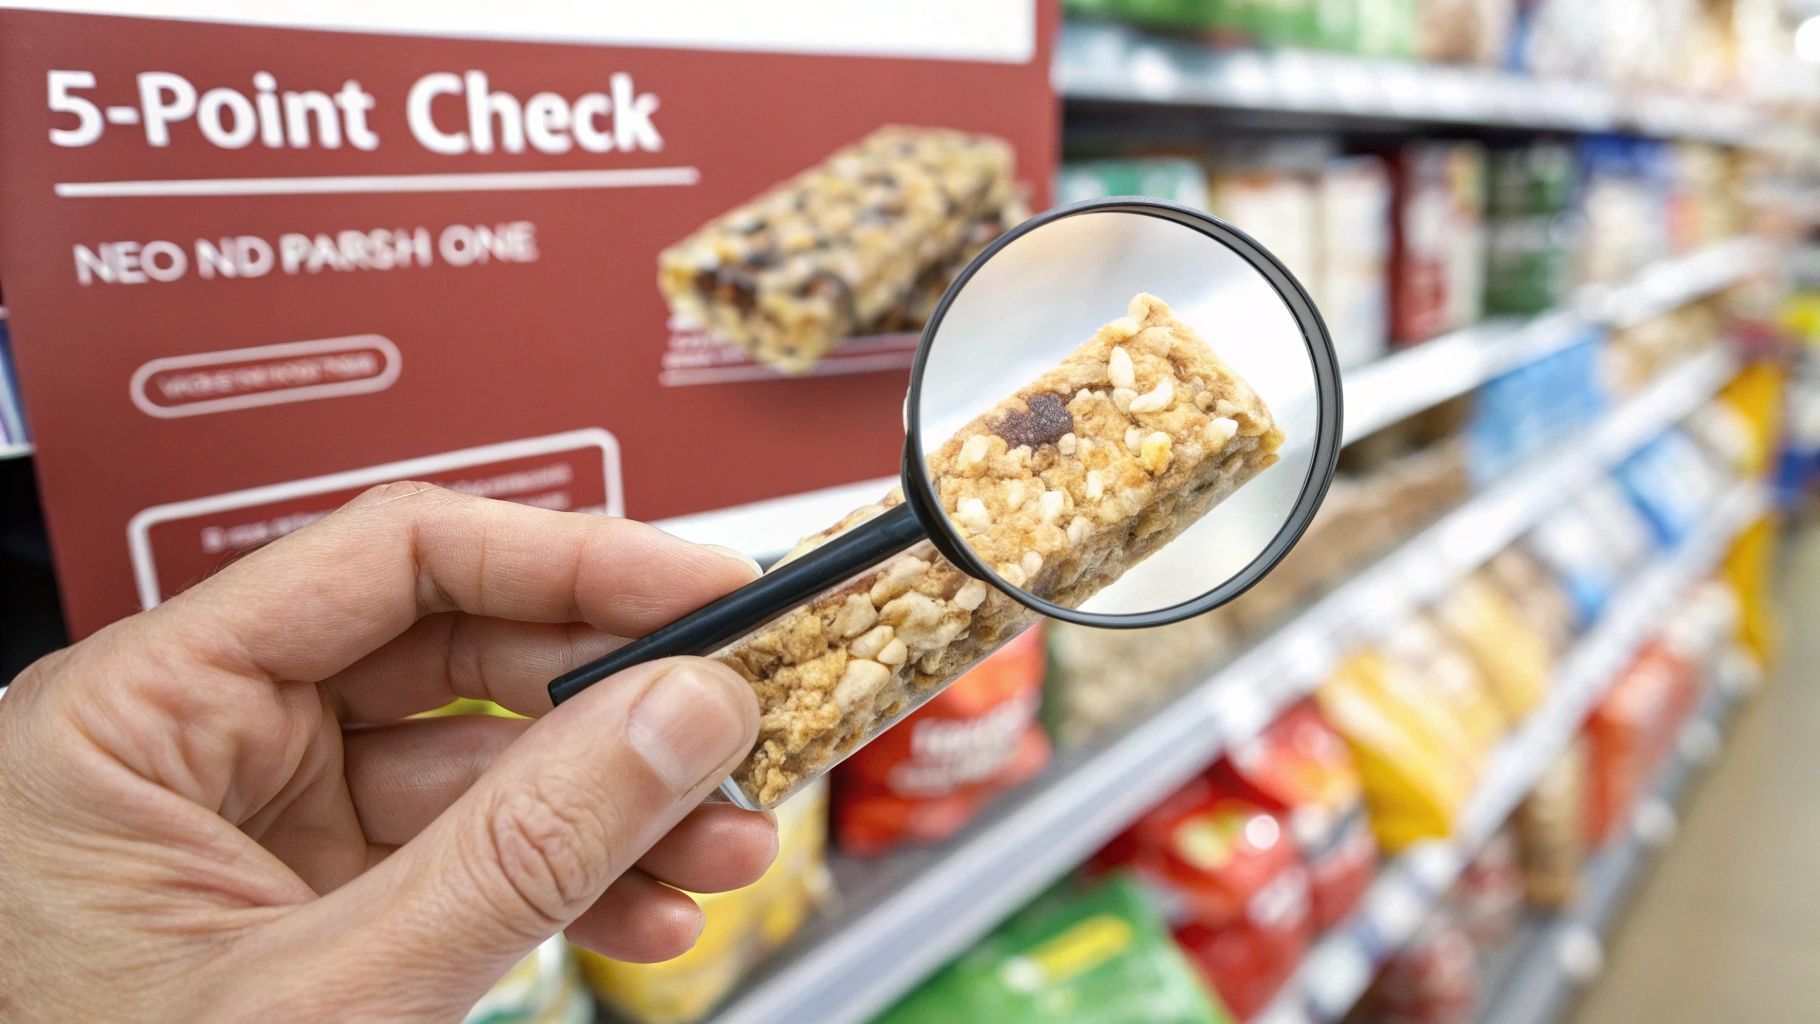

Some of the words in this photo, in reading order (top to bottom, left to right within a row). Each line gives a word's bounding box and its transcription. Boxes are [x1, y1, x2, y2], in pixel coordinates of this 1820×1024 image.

[47, 70, 379, 150] 5-Point
[406, 70, 663, 154] Check
[73, 240, 188, 286] NEO
[195, 235, 274, 279] ND
[438, 220, 540, 266] ONE
